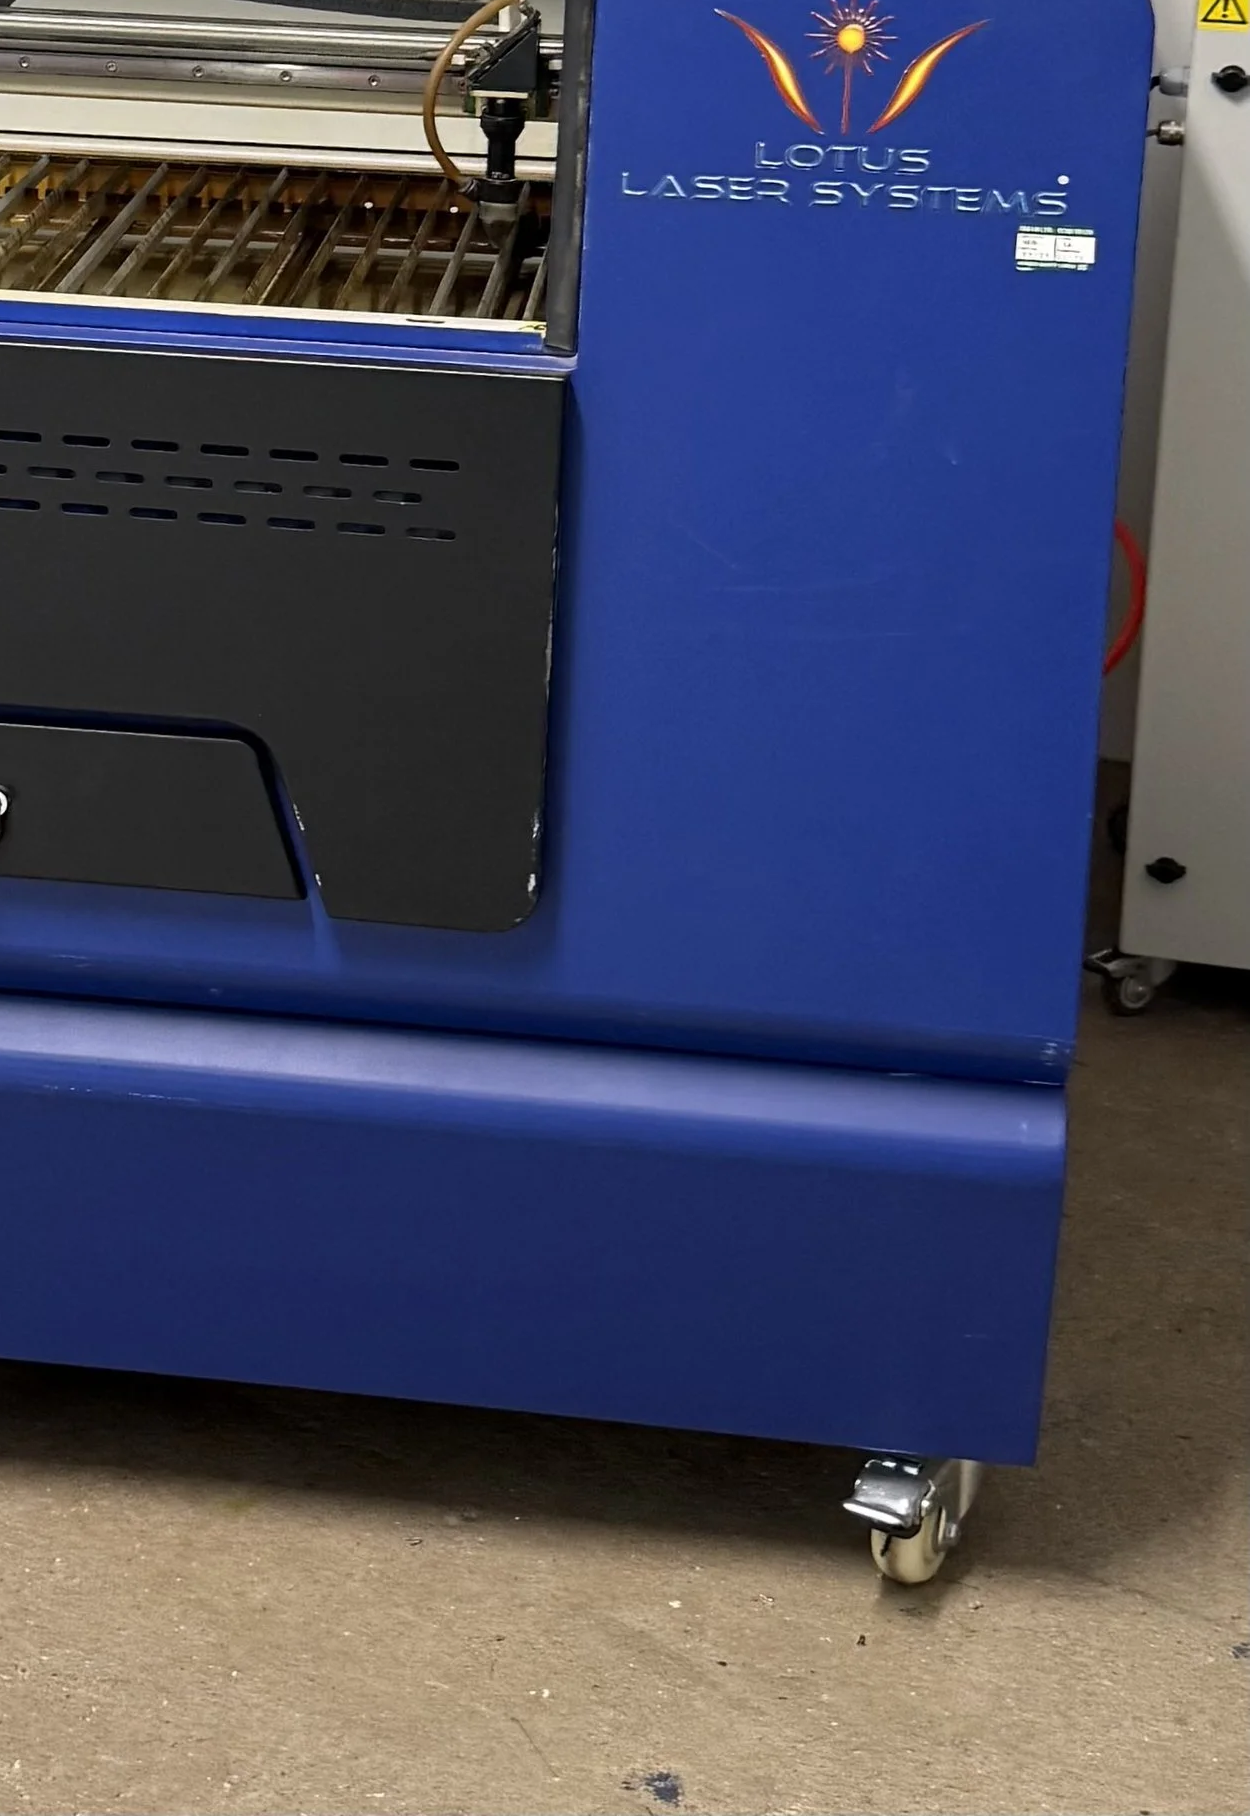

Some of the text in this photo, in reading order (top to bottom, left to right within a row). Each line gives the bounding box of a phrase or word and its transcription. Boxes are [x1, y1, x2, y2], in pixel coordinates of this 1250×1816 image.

[755, 141, 932, 175] LOTUS
[622, 171, 1068, 217] LASER SYSTEMS
